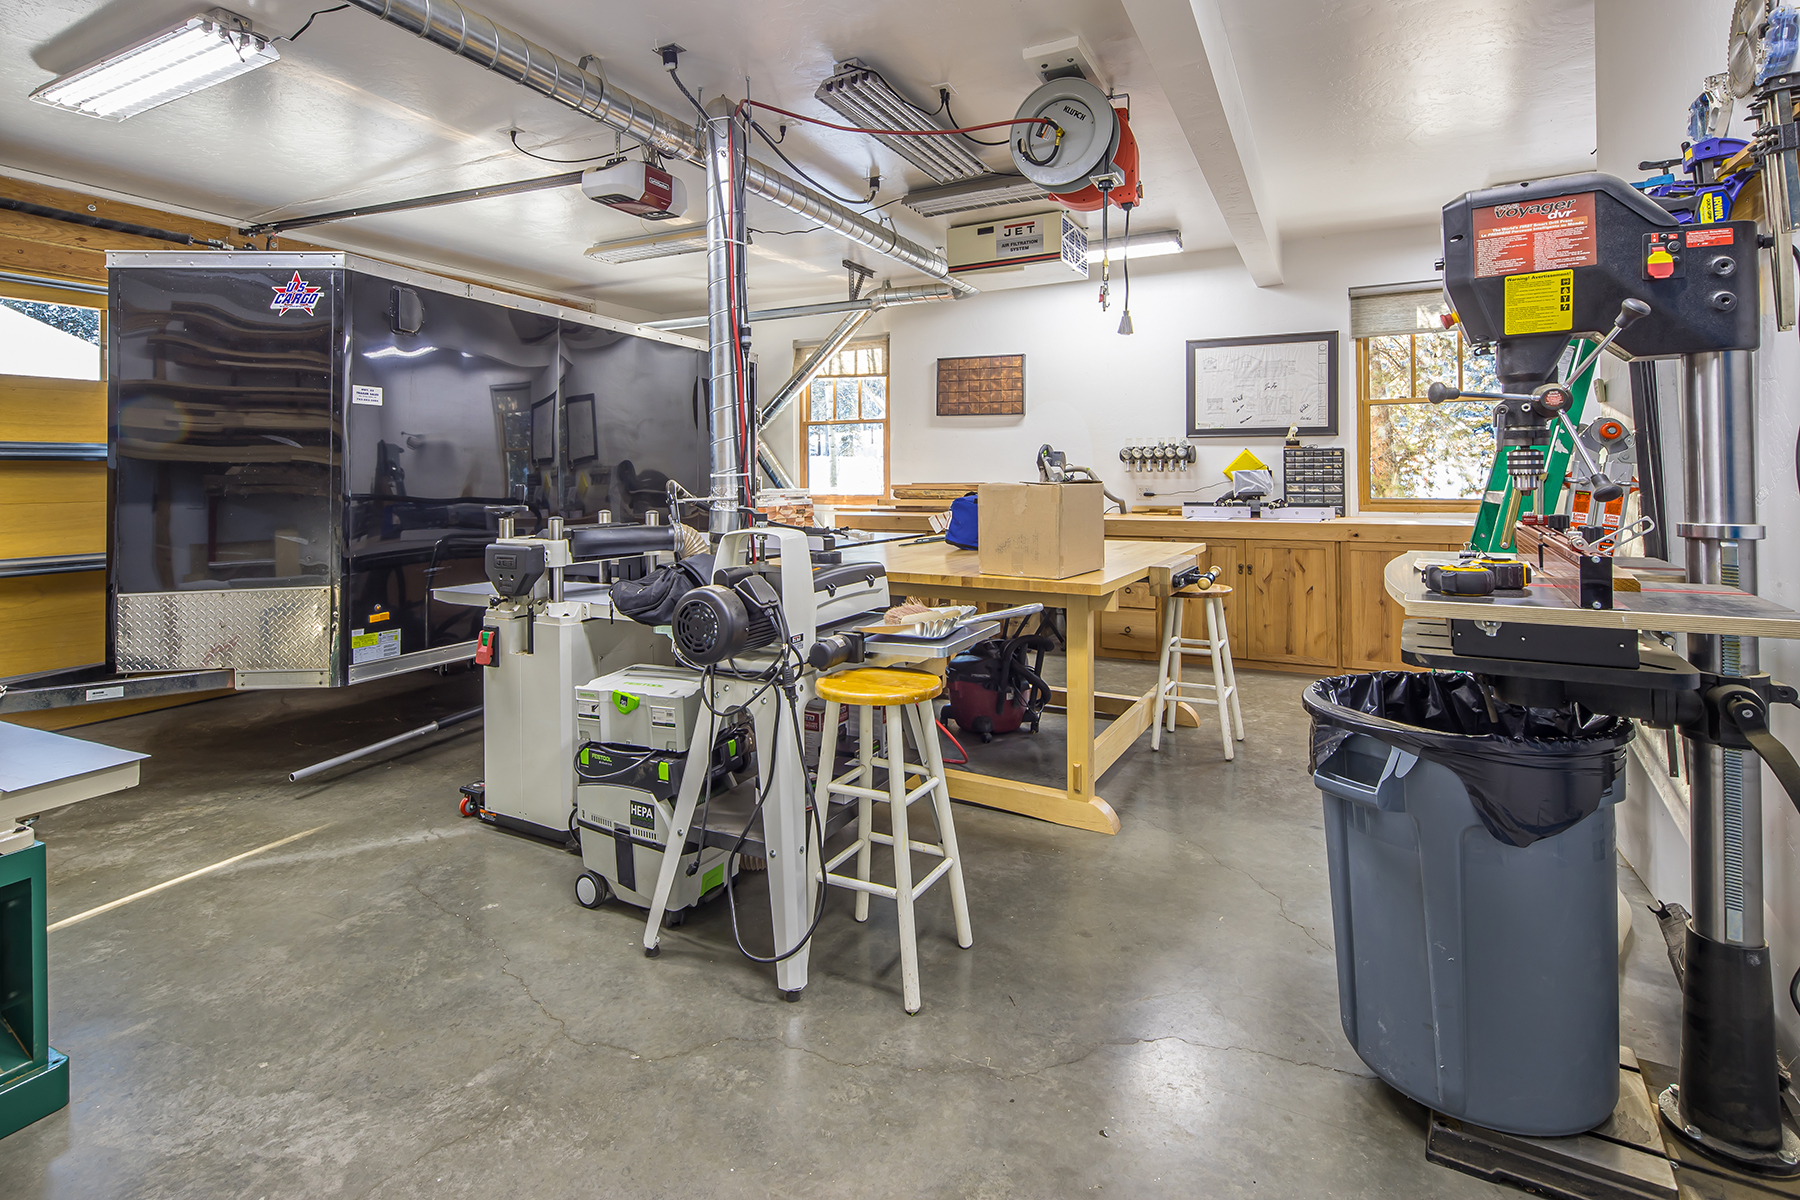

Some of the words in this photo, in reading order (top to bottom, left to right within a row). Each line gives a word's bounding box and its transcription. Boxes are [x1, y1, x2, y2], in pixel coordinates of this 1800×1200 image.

[1063, 105, 1086, 121] KLUTCH
[1494, 199, 1576, 219] voyager
[1547, 209, 1572, 220] dvr
[1713, 196, 1724, 220] IRWIN
[1004, 225, 1035, 237] JET
[1010, 239, 1038, 247] FILTRATION
[274, 293, 318, 304] CARGO
[631, 804, 653, 819] HEPA
